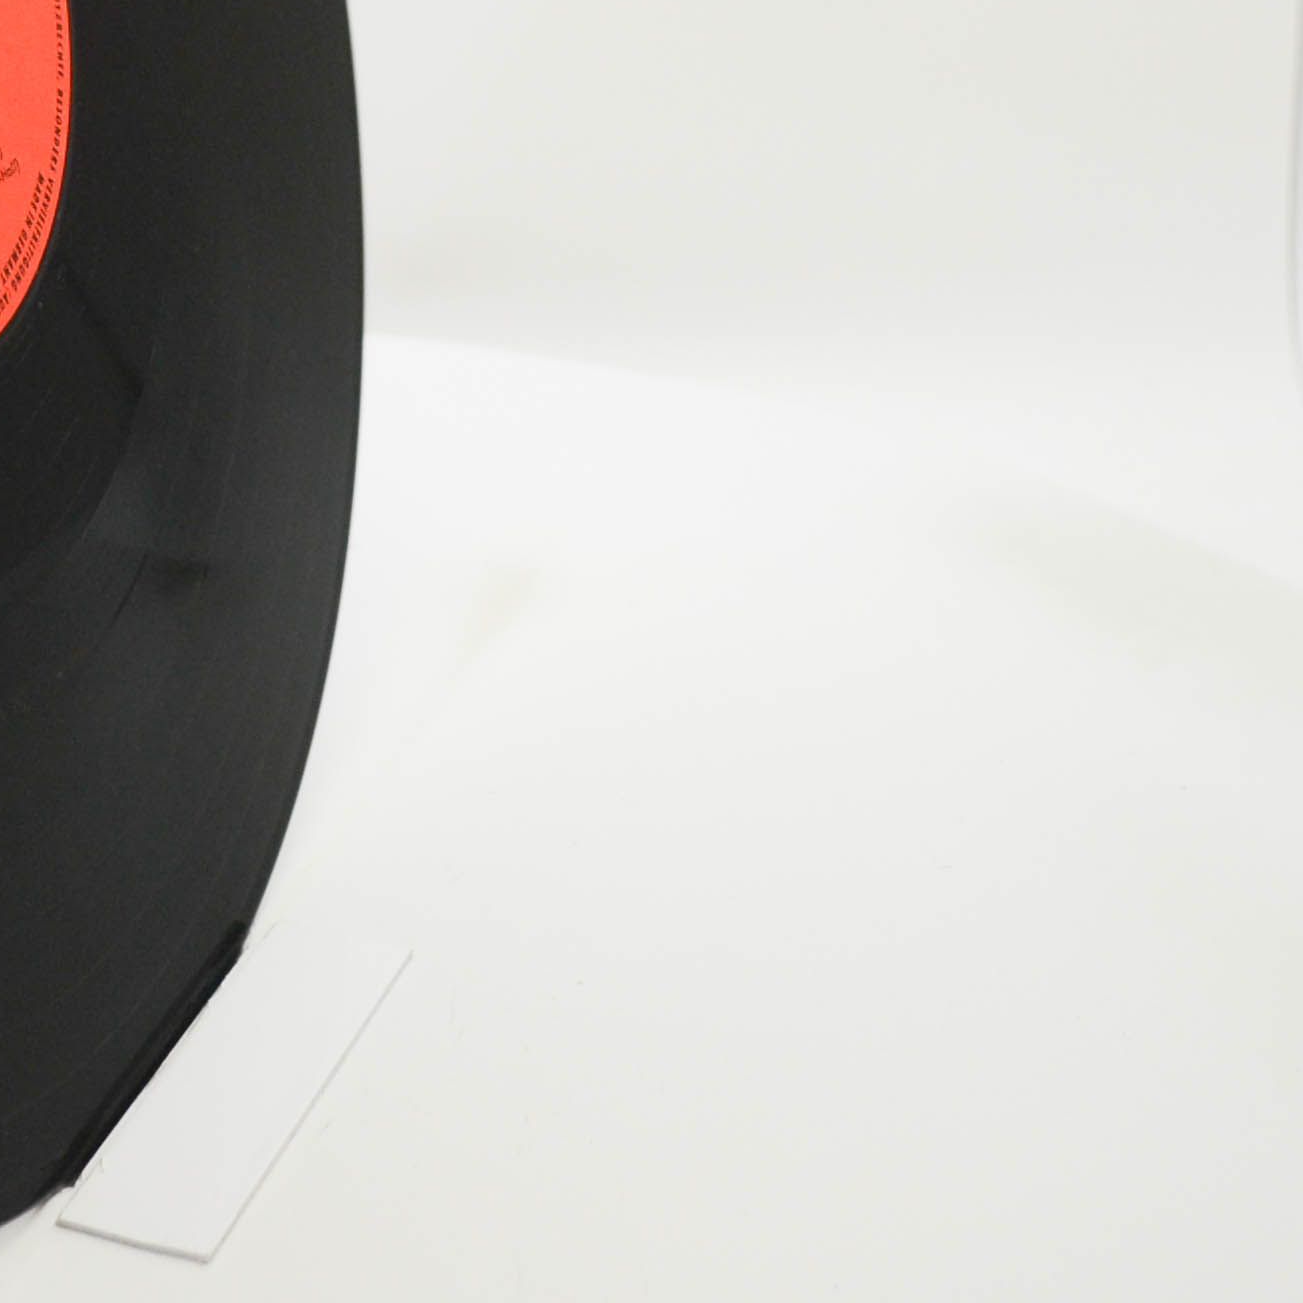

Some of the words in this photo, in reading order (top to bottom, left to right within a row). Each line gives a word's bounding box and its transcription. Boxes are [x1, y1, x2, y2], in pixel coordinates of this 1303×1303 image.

[30, 171, 45, 213] MADE
[25, 210, 35, 229] IN
[0, 228, 27, 285] GERMANY
